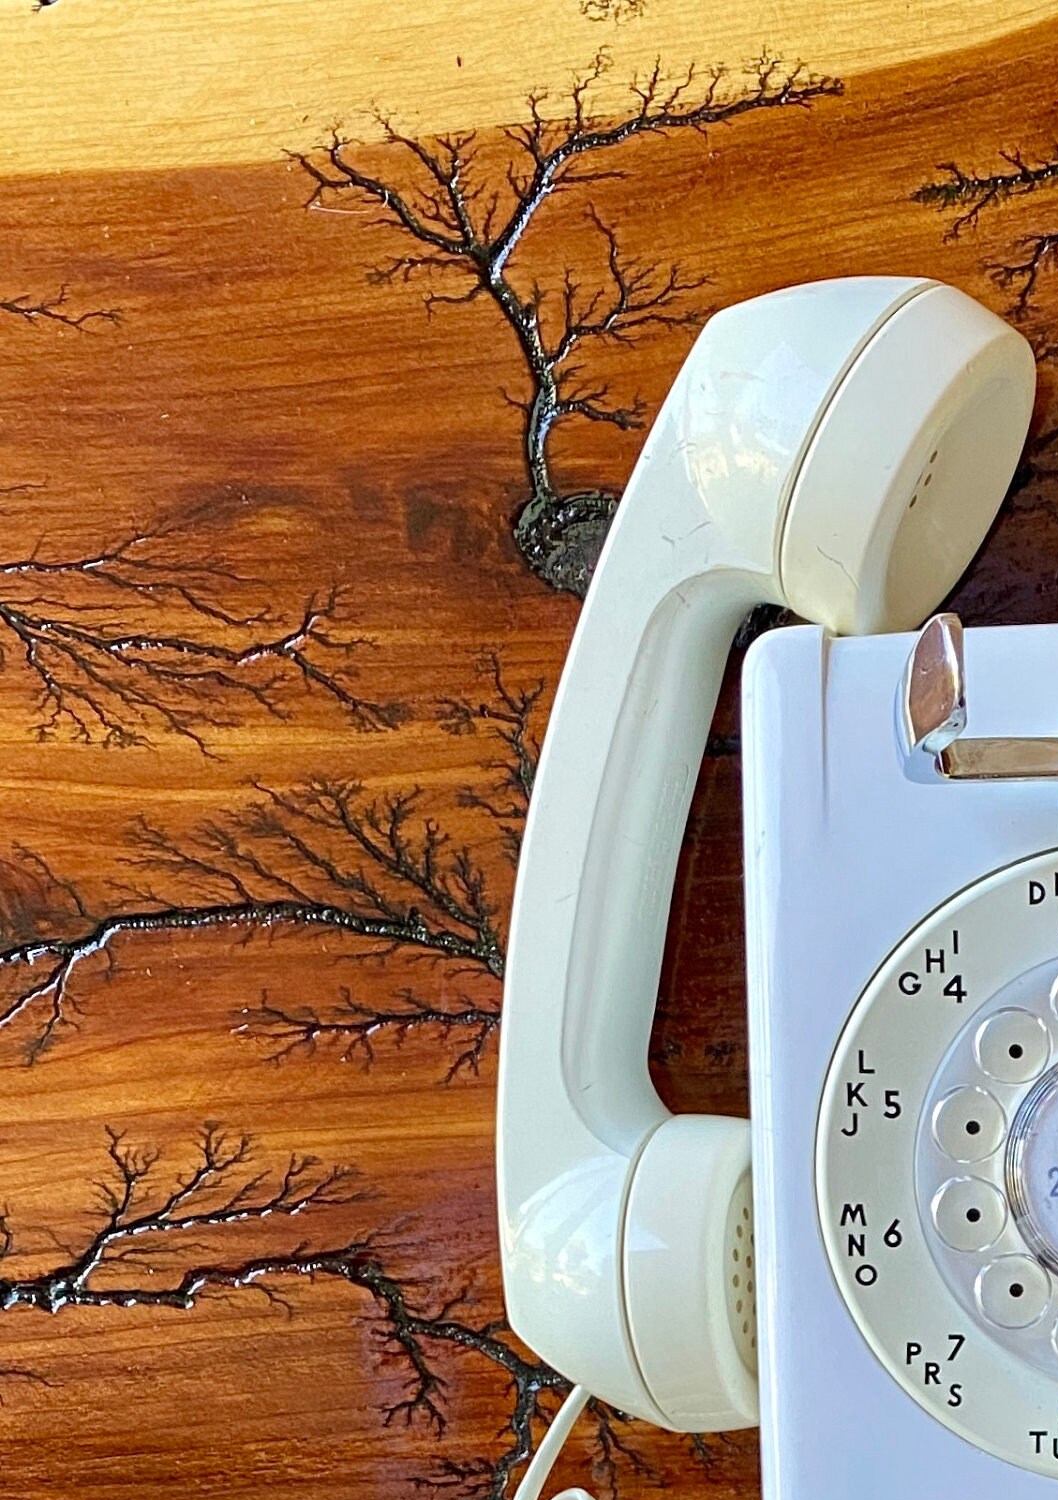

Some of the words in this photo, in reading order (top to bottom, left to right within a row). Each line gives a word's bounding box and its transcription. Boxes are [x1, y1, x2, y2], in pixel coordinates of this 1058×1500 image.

[943, 974, 968, 1004] 4
[883, 1090, 902, 1119] 5
[883, 1218, 903, 1248] 6
[947, 1334, 966, 1361] 7
[906, 1342, 962, 1407] PRS
